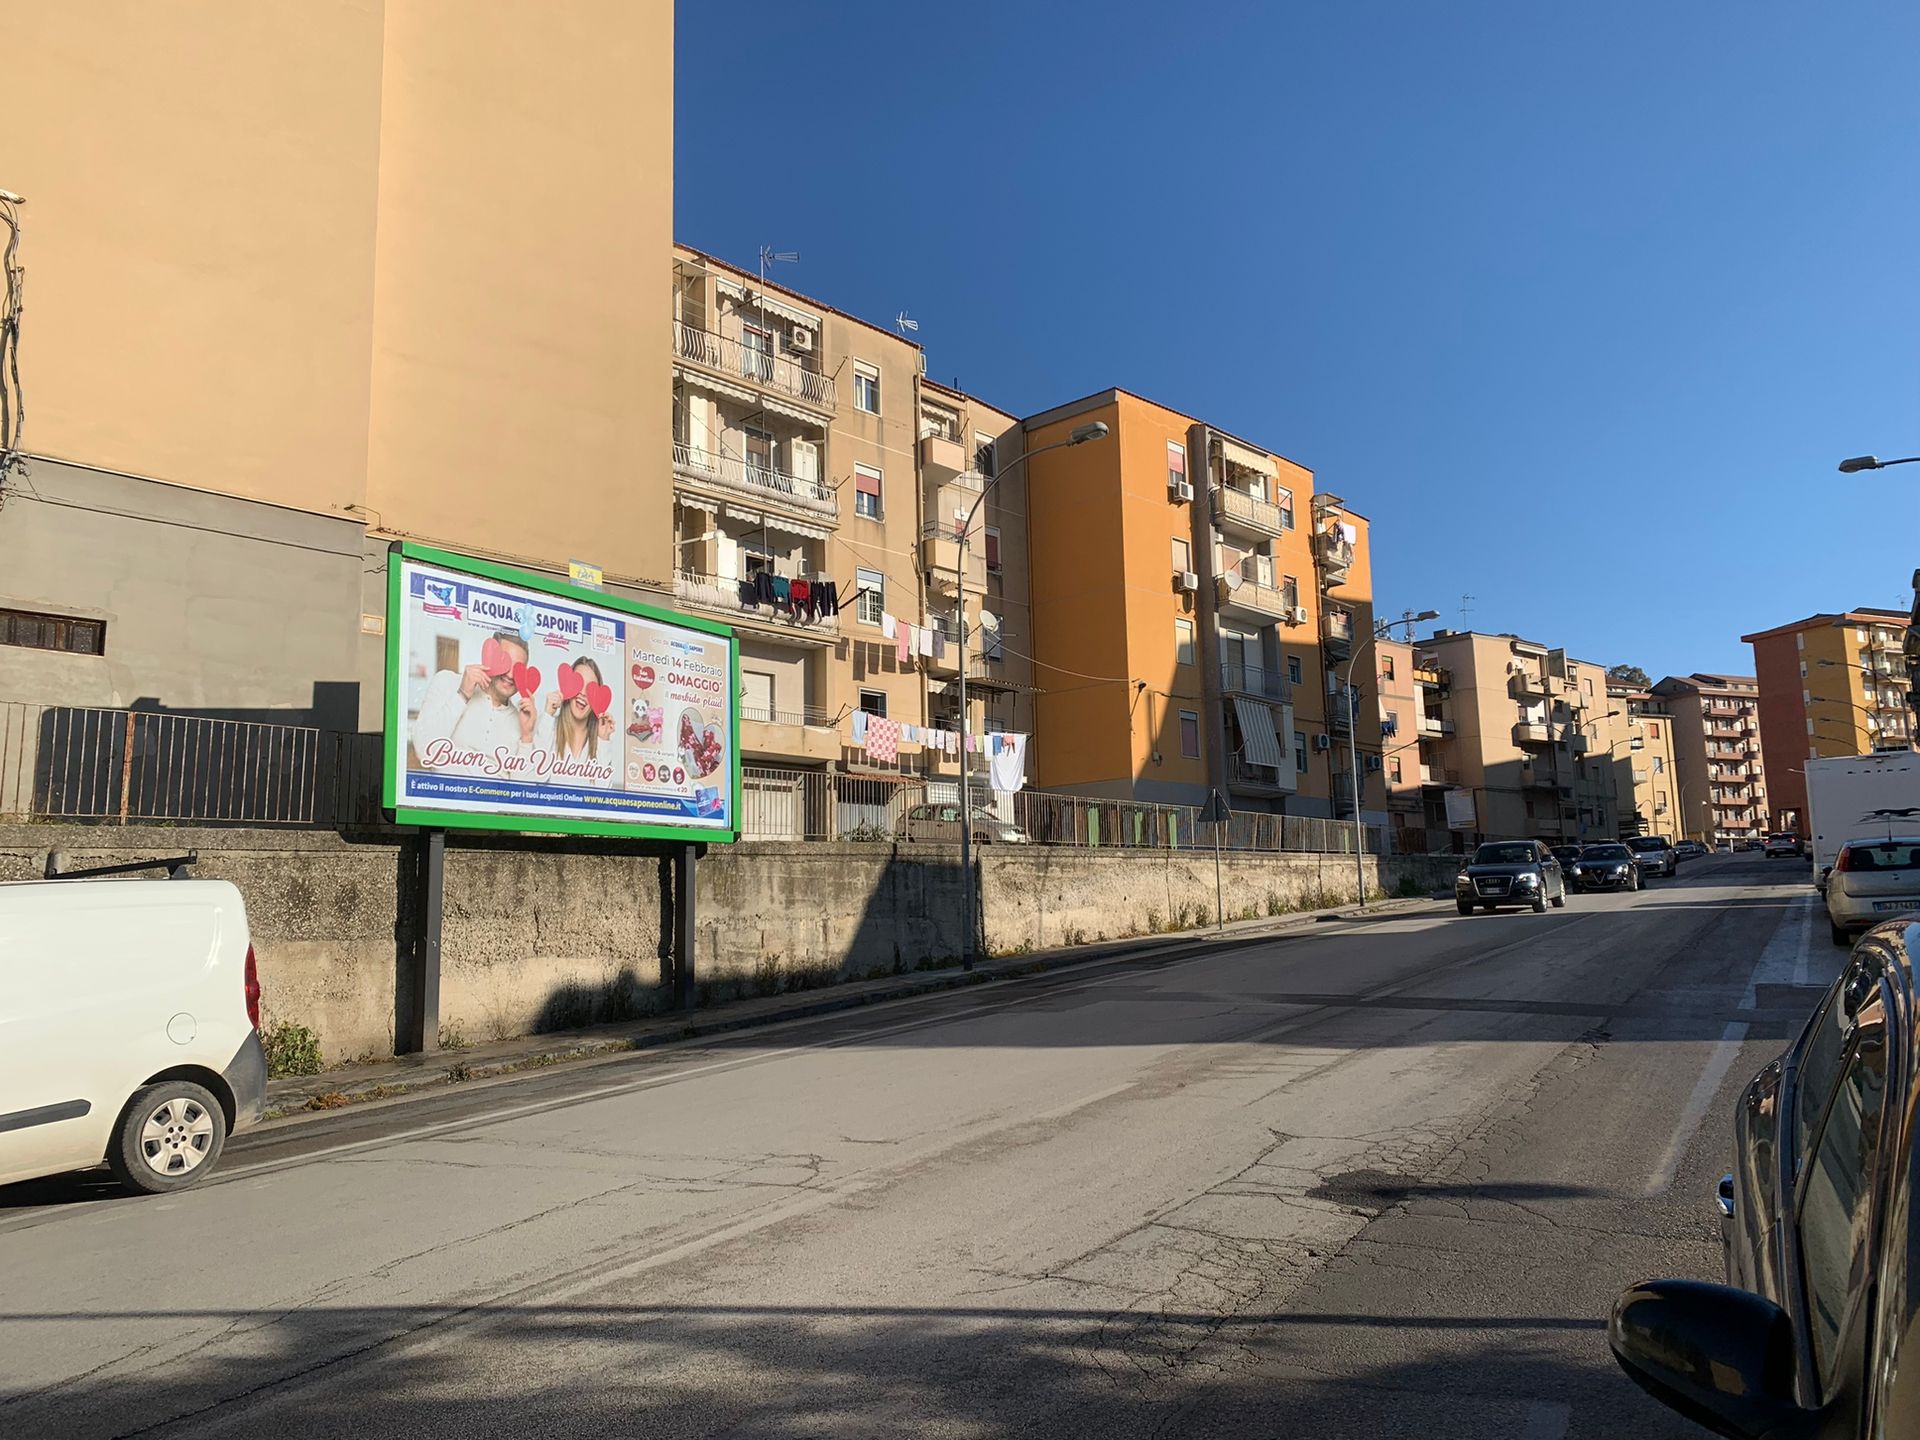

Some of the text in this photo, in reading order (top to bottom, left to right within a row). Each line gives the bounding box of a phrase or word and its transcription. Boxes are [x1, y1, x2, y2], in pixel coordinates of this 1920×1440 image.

[473, 599, 513, 621] ACQUA
[536, 613, 578, 635] SAPONE
[671, 656, 682, 668] 14
[683, 659, 723, 677] Febbraio
[670, 692, 701, 704] morbido
[703, 697, 722, 709] plaid
[422, 738, 614, 780] Buon San Valentino
[417, 782, 439, 791] attivo
[439, 783, 444, 791] il
[445, 785, 468, 793] nostro
[469, 786, 510, 797] E-Commerce
[510, 791, 522, 800] per
[540, 793, 564, 802] acquisti
[564, 794, 583, 802] Online
[584, 795, 681, 810] www.acquaesaponeonline.it
